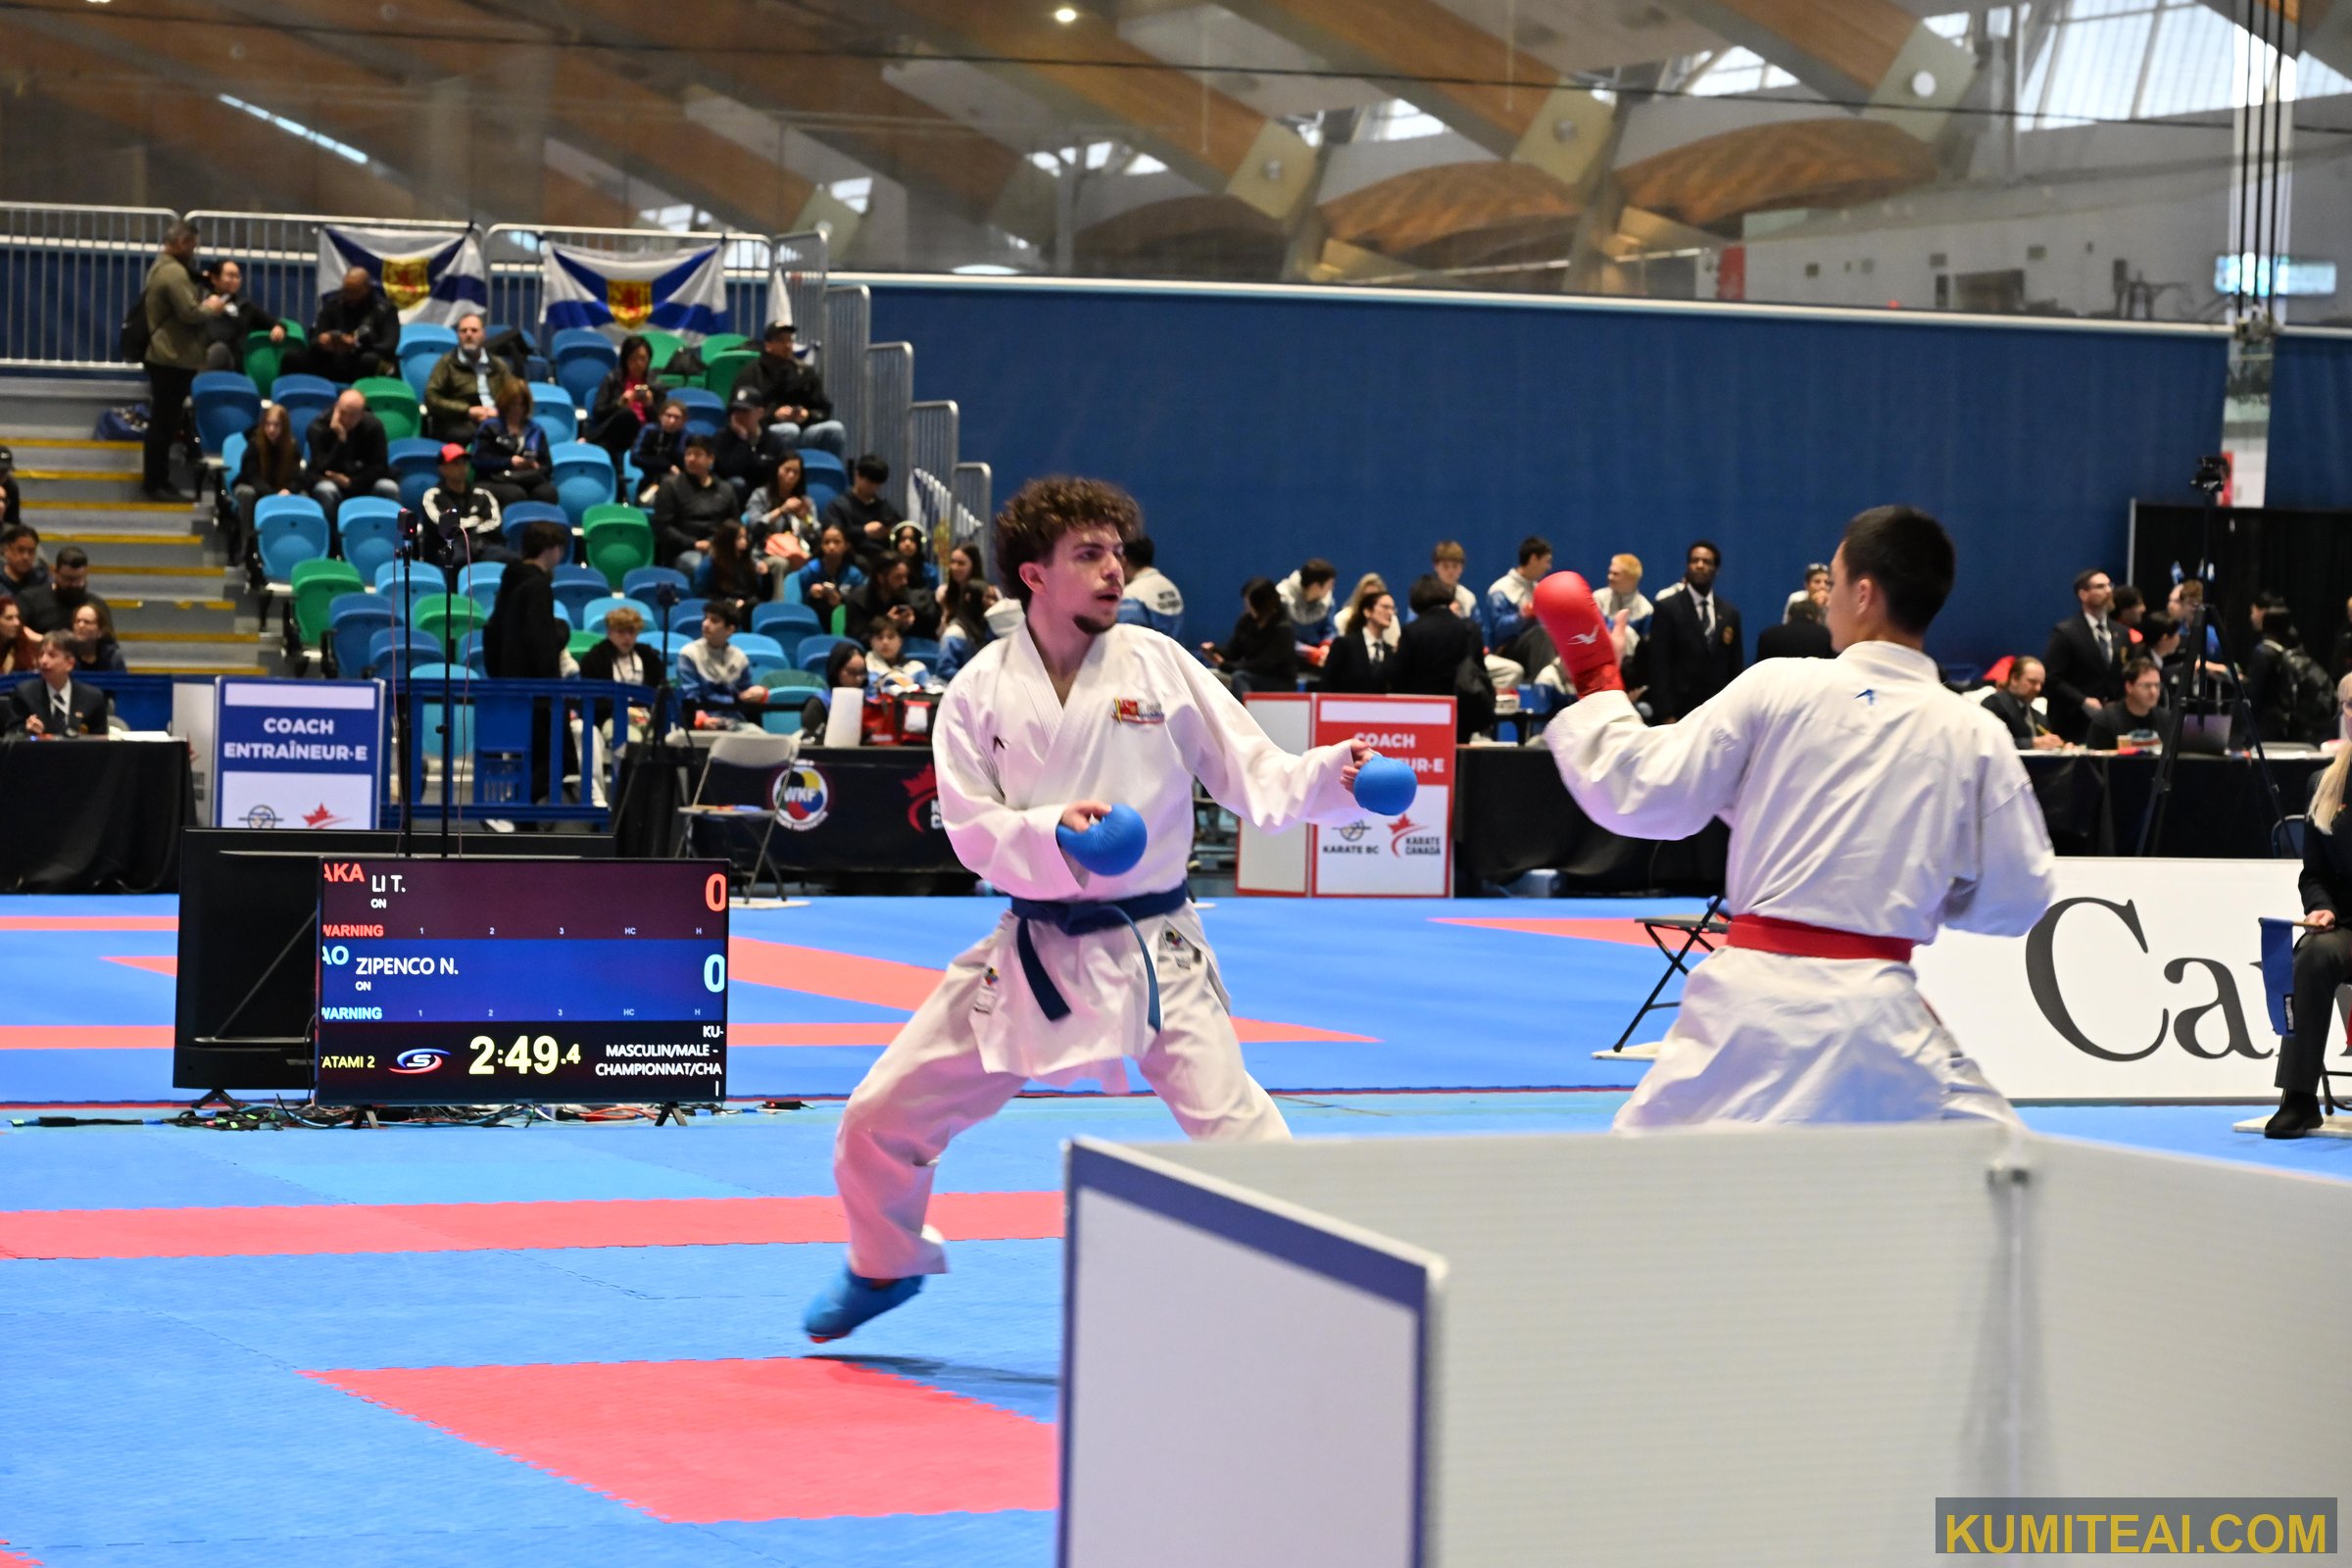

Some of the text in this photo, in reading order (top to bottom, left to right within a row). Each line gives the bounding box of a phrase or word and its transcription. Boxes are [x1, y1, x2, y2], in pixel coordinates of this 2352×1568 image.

[264, 717, 334, 735] COACH
[1323, 846, 1379, 855] KARATE BC
[1405, 847, 1441, 856] CANADA
[371, 875, 406, 893] LI T.
[705, 873, 726, 912] 0
[370, 899, 387, 908] ON
[356, 957, 459, 975] ZIPENCO N.
[704, 954, 726, 993] 0
[355, 981, 371, 991] ON
[703, 1025, 724, 1038] KU-
[606, 1044, 710, 1058] MASCULIN/MALE
[320, 1055, 375, 1068] ATAMI 2
[595, 1062, 722, 1077] CHAMPIONNAT/CHA
